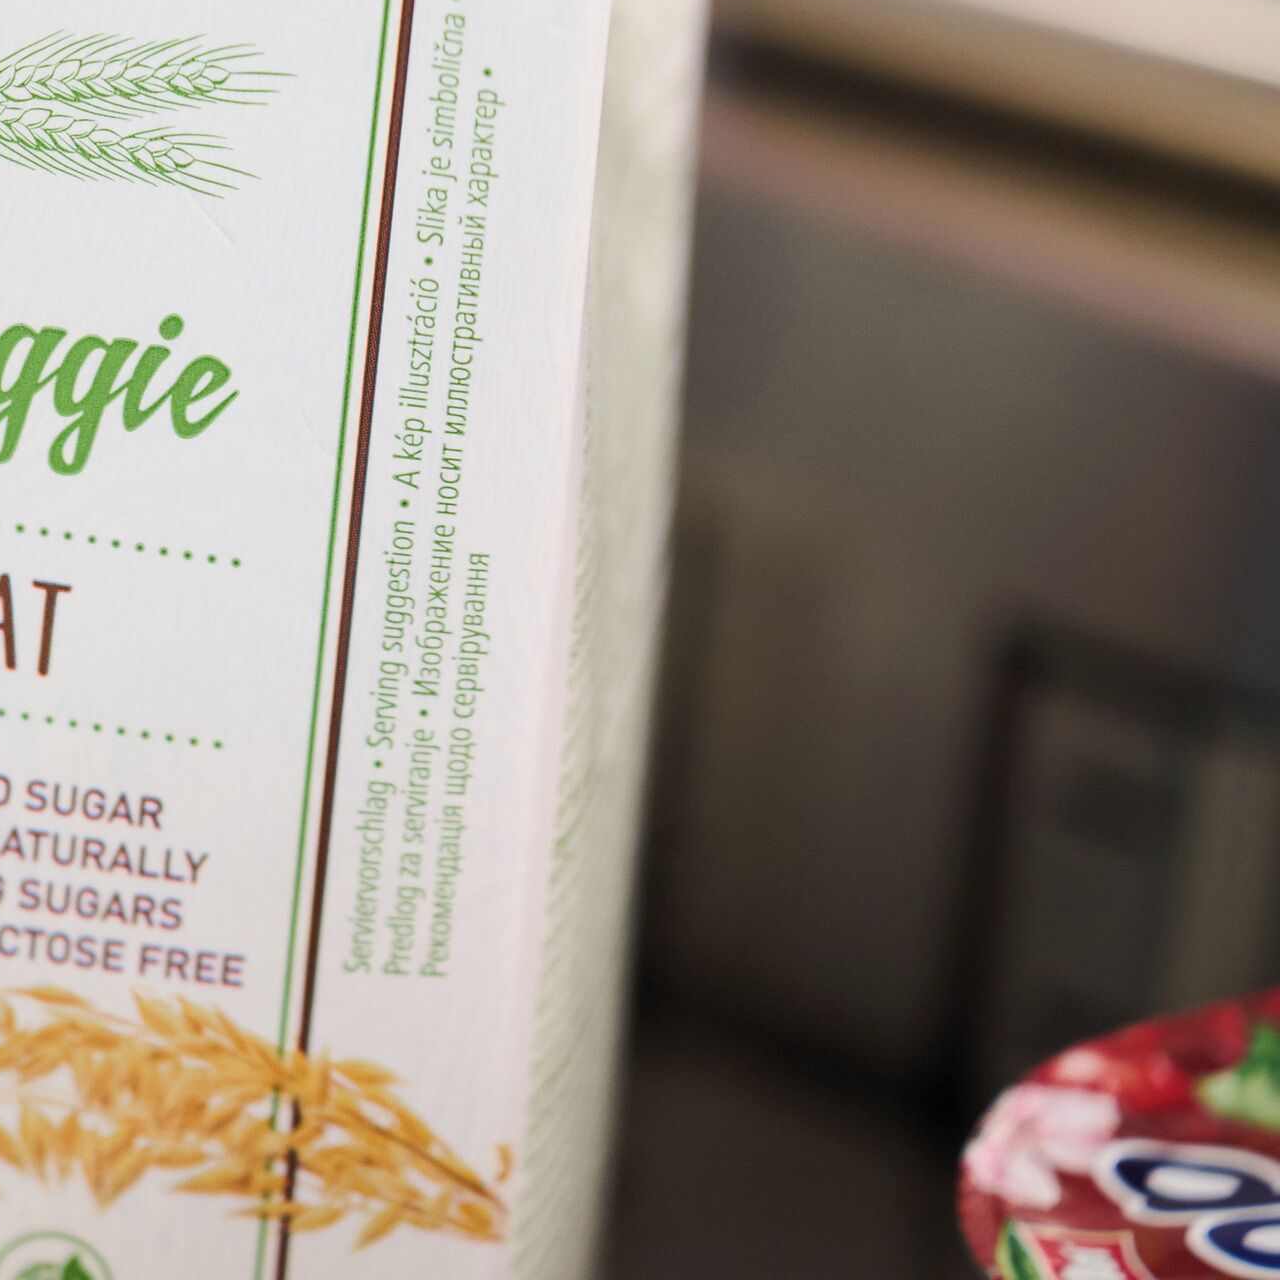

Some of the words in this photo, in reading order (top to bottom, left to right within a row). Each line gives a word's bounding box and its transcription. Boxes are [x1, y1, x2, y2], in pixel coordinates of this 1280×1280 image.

[429, 12, 467, 148] simbolična
[423, 154, 457, 181] je
[467, 88, 503, 206] характер
[415, 186, 448, 245] Slika
[399, 276, 441, 409] illusztráció
[444, 213, 486, 436] иллюстративный
[392, 416, 431, 461] kép
[395, 469, 421, 491] A
[436, 443, 464, 516] носит
[381, 518, 416, 652] suggestion
[412, 522, 456, 697] Изображение
[451, 551, 490, 720] сервірування
[366, 659, 407, 748] Serving
[24, 780, 165, 830] SUGAR
[403, 727, 440, 843] serviranje
[447, 726, 474, 797] щодо
[18, 878, 184, 931] SUGARS
[343, 780, 395, 973] Serviervorschlag
[399, 852, 422, 878] za
[419, 804, 464, 977] Рекомендація
[138, 944, 248, 988] FREE
[383, 885, 422, 976] Predlog
